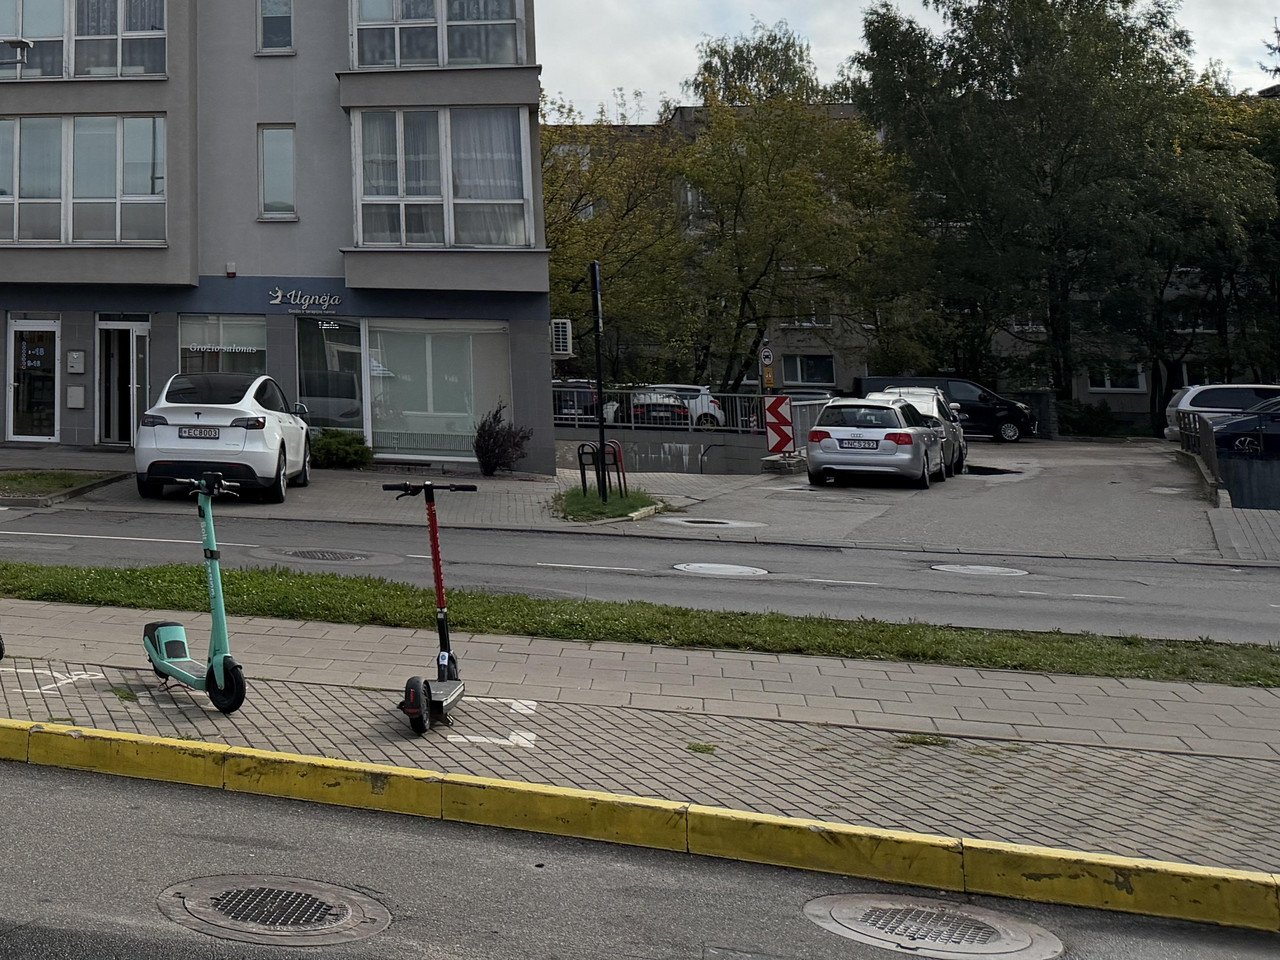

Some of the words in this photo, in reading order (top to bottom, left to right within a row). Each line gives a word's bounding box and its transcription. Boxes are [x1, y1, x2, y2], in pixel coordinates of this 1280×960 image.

[286, 289, 342, 310] Ugnėja
[189, 342, 220, 352] Grožio
[222, 344, 257, 353] salonas
[187, 428, 217, 437] EC8003
